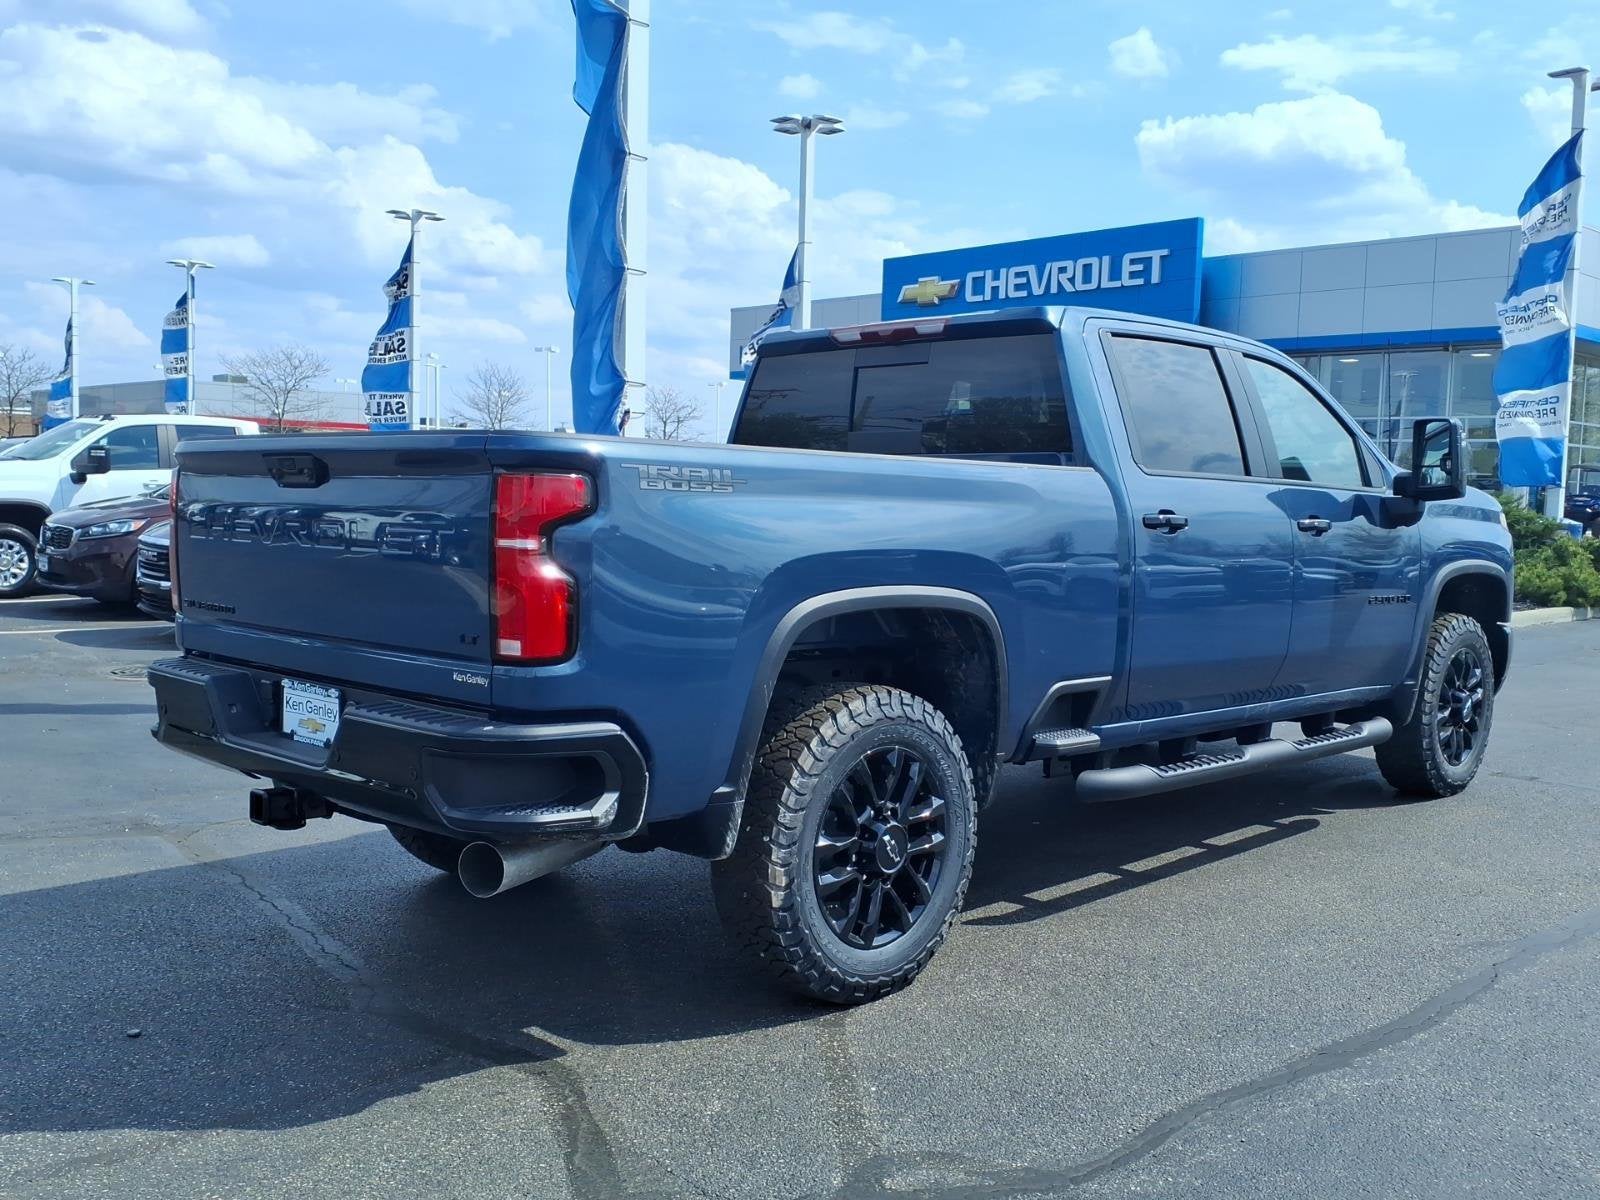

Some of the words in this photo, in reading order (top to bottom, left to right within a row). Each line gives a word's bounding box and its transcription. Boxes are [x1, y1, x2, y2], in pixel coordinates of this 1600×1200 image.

[965, 249, 1170, 303] CHEVROLET
[621, 463, 747, 484] TRAIL
[640, 479, 734, 493] BOSS
[293, 680, 306, 692] Ken
[453, 671, 467, 682] Ken
[466, 673, 489, 688] Ganley
[285, 695, 305, 712] Ken
[305, 700, 338, 723] Ganley
